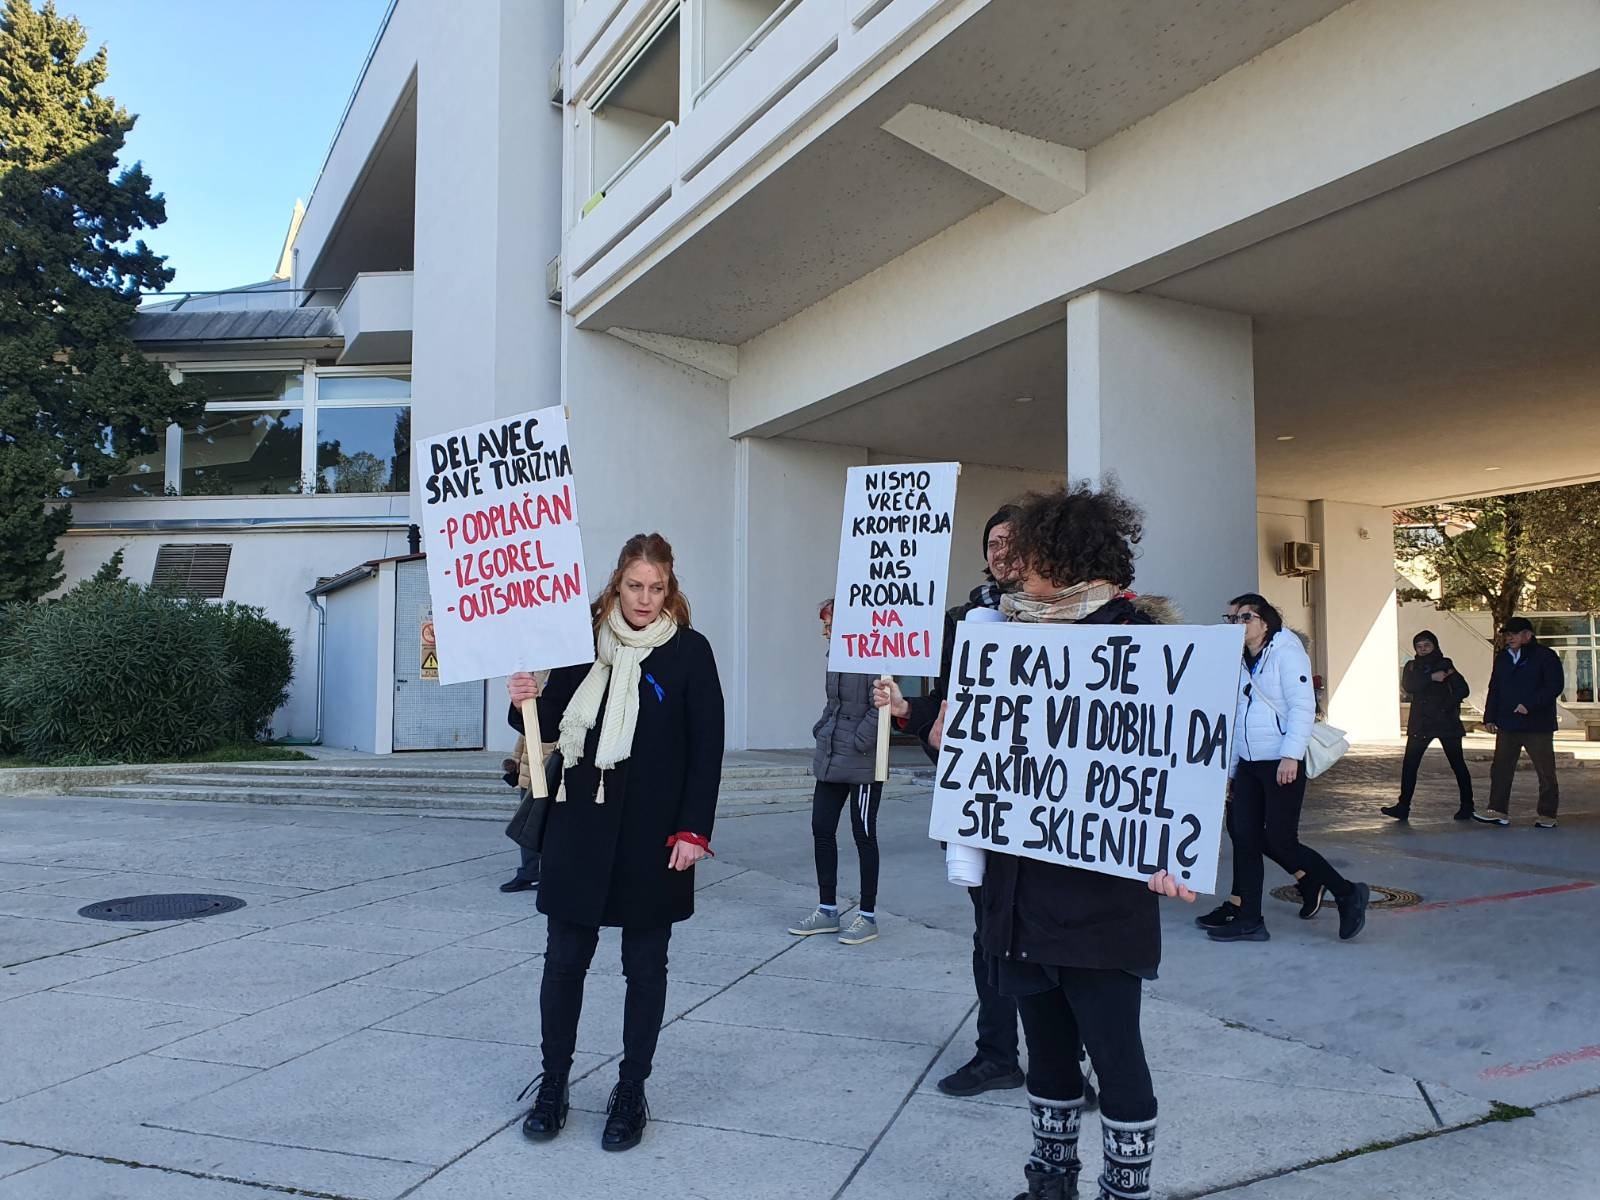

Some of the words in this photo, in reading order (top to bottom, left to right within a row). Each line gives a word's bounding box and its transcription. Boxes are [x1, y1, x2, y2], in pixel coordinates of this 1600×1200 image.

[431, 418, 544, 475] DELAVEC
[425, 466, 483, 504] SAVE
[490, 444, 573, 490] TURIZMA
[865, 471, 931, 491] NISMO
[867, 488, 932, 511] VREČA
[852, 512, 951, 537] KROMPIRJA
[870, 540, 893, 559] DA
[900, 539, 917, 557] BI
[869, 560, 911, 580] NAS
[849, 580, 935, 607] PRODALI
[872, 609, 903, 627] NA
[841, 629, 930, 658] TRŽNICI
[958, 639, 999, 687] LE
[1010, 644, 1071, 690] KAJ
[1085, 635, 1141, 695] STE
[1163, 643, 1194, 695] V
[946, 686, 1033, 745] ŽEPE
[1046, 695, 1081, 749] VI
[1186, 708, 1228, 769] DA
[1085, 760, 1175, 819] POSEL
[958, 793, 1013, 845] STE
